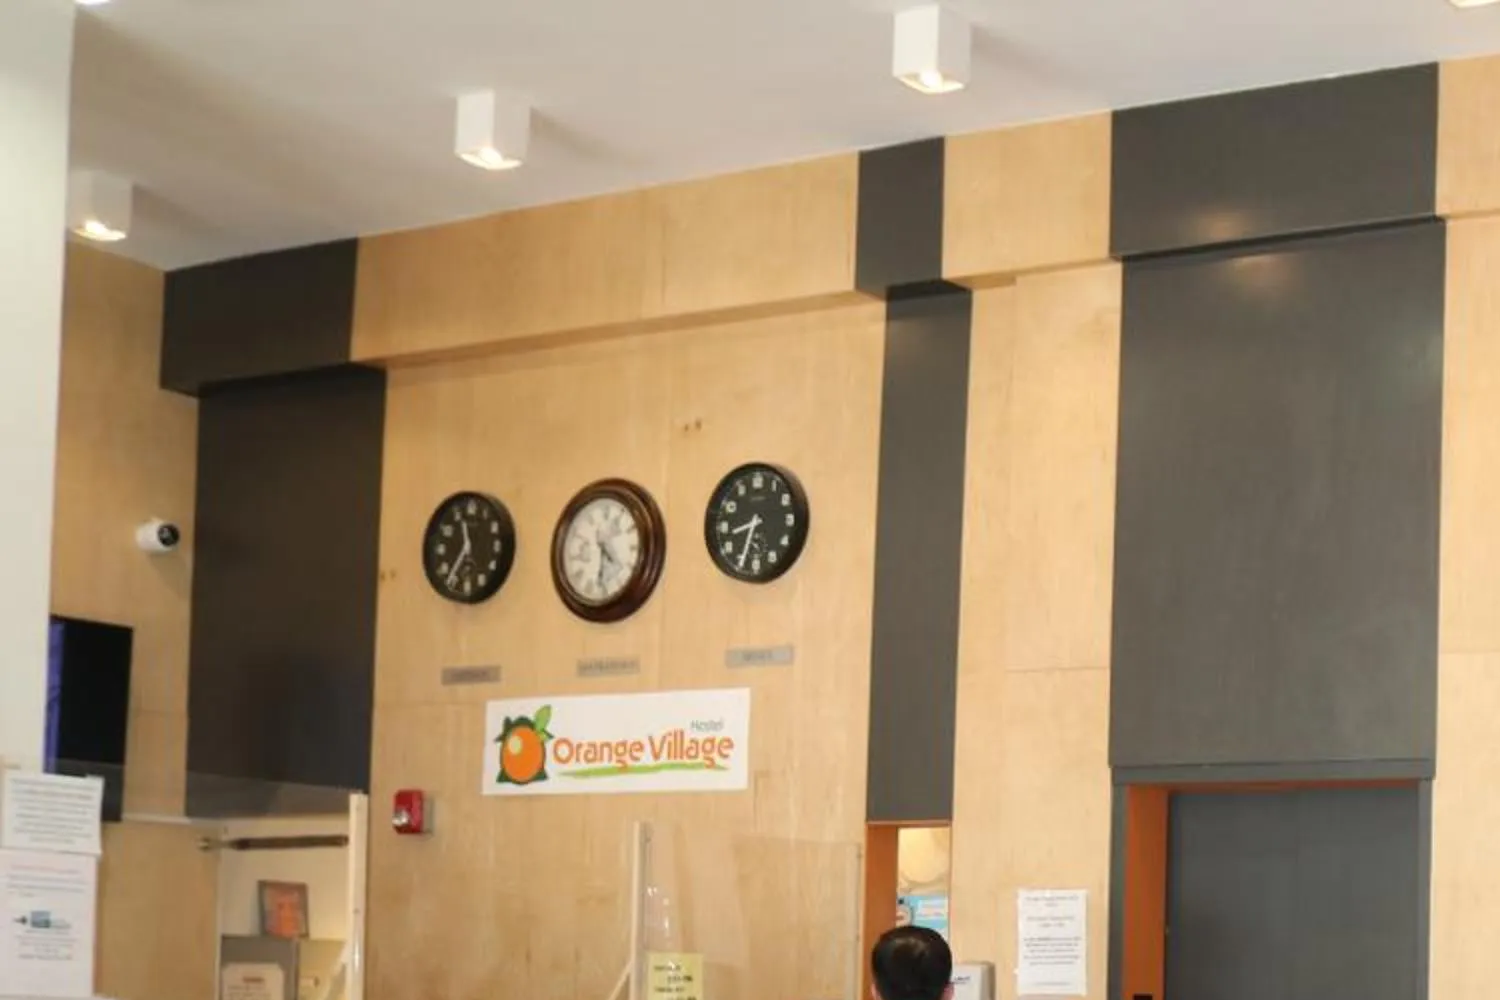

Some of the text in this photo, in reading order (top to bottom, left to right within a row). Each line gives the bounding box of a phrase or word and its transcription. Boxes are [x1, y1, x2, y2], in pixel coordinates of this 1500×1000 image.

[689, 718, 724, 732] Hostel
[553, 728, 735, 773] Orange Village
